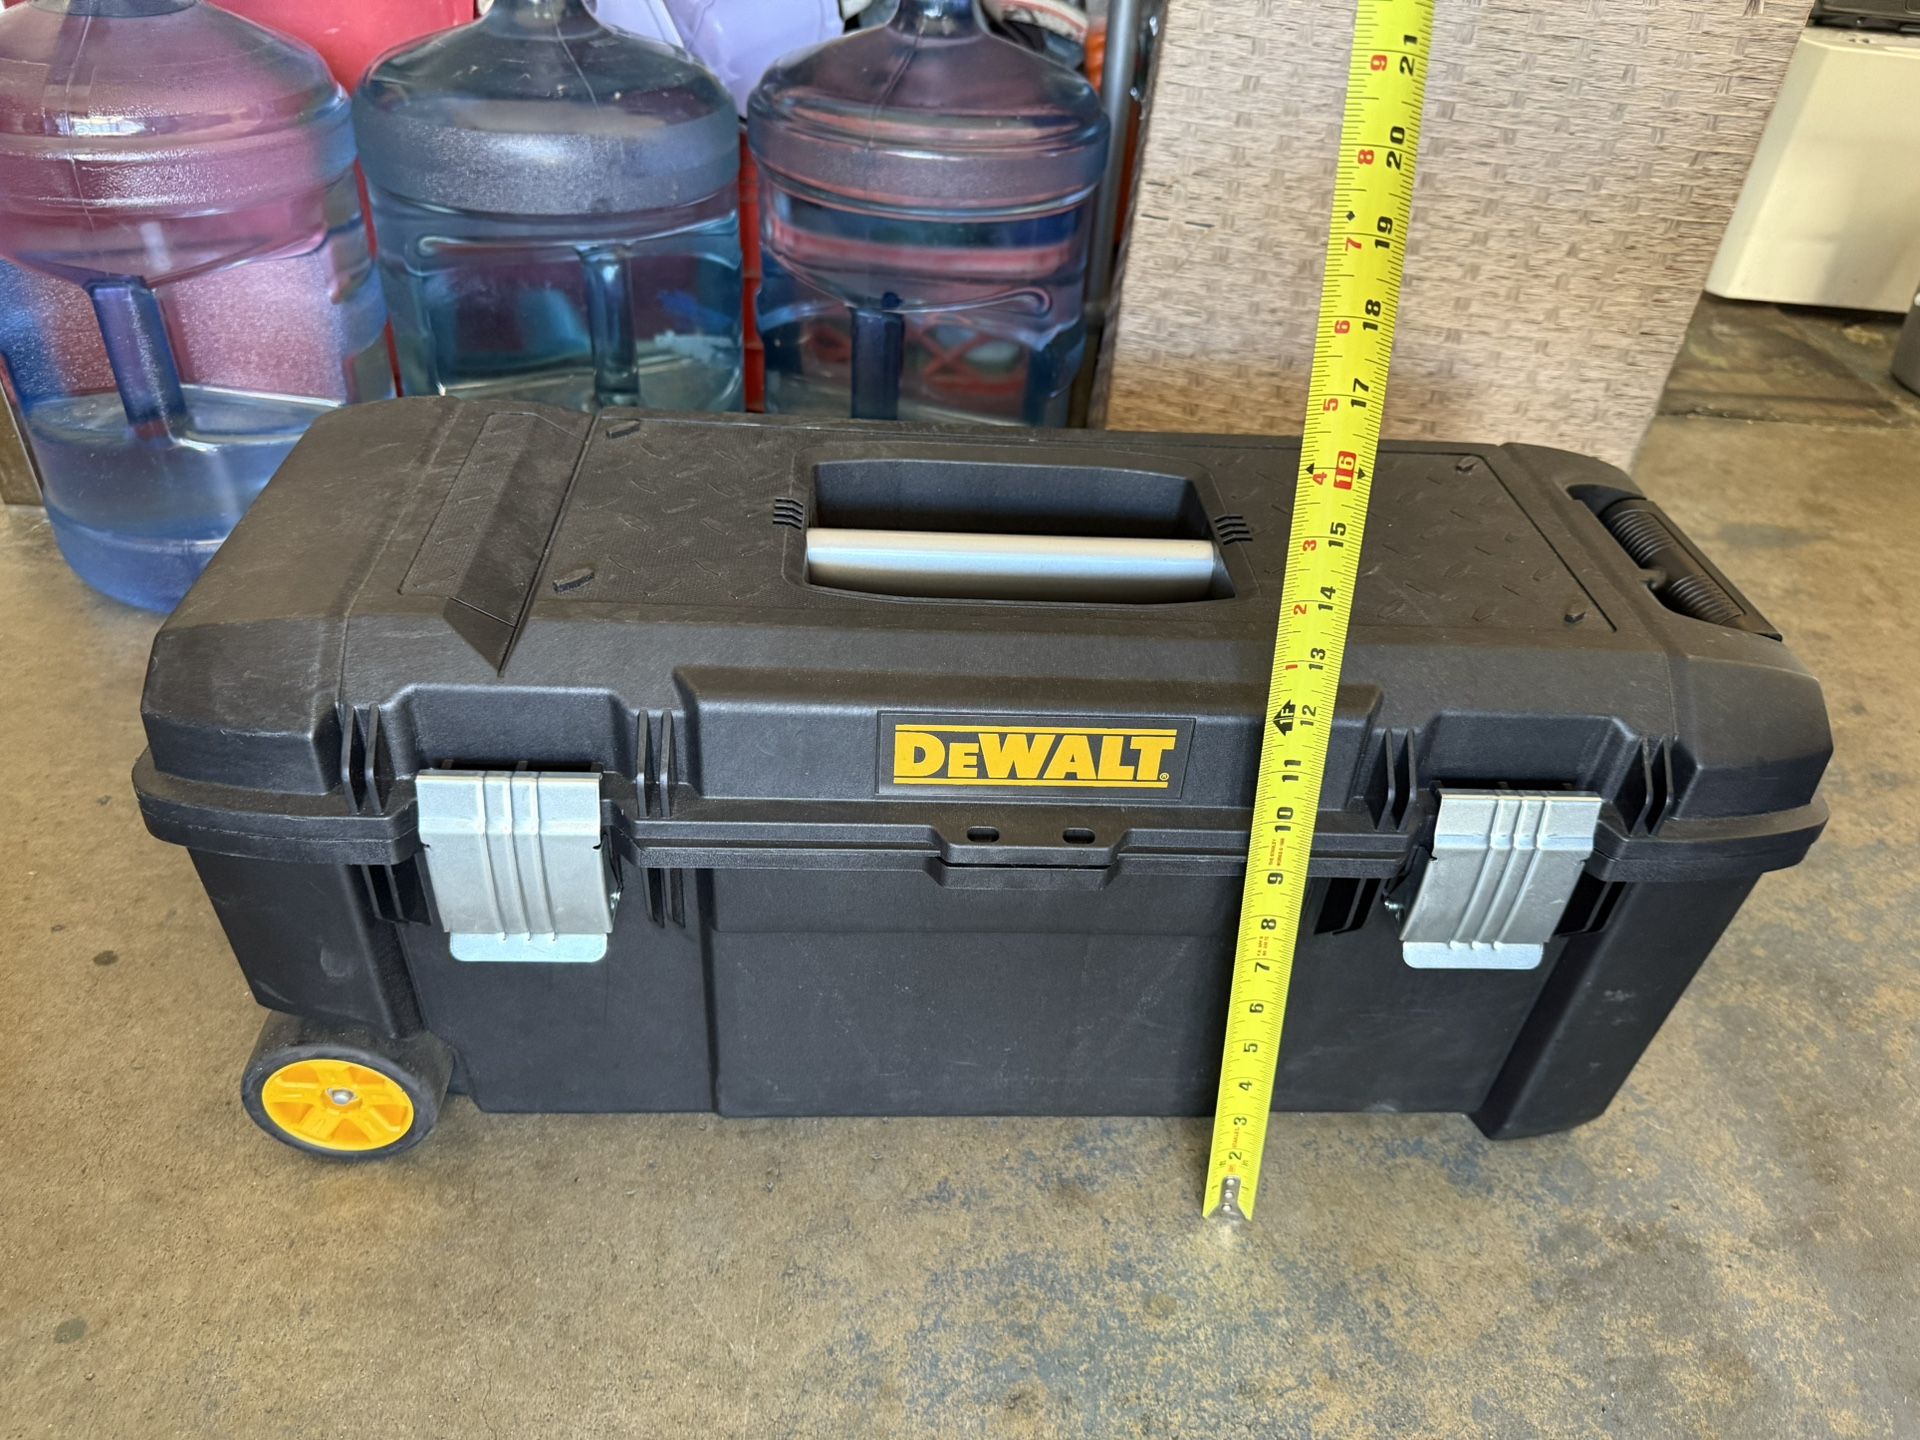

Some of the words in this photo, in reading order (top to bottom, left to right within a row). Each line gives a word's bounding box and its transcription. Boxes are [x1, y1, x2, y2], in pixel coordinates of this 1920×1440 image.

[1370, 54, 1387, 71] 9
[1386, 126, 1405, 170] 20
[1357, 149, 1374, 165] 8
[1374, 216, 1393, 249] 19
[1345, 237, 1362, 251] 7
[1363, 299, 1381, 331] 18
[1334, 320, 1350, 334] 6
[1351, 378, 1369, 408] 17
[1323, 398, 1338, 411] 5
[1335, 454, 1355, 483] 16
[1312, 472, 1327, 485] 4
[1328, 522, 1346, 548] 15
[1302, 540, 1316, 551] 3
[1318, 586, 1336, 610] 14
[1294, 604, 1306, 615] 2
[1309, 648, 1325, 670] 13
[1300, 705, 1316, 727] 12
[1282, 760, 1301, 782] 11
[1275, 807, 1293, 832] 10
[1267, 873, 1283, 885] 9
[1261, 919, 1276, 930] 8
[1254, 962, 1270, 972] 7
[1249, 1003, 1264, 1013] 6
[1243, 1043, 1258, 1053] 5
[1238, 1080, 1252, 1091] 4
[1233, 1117, 1247, 1126] 3
[1229, 1151, 1242, 1160] 2
